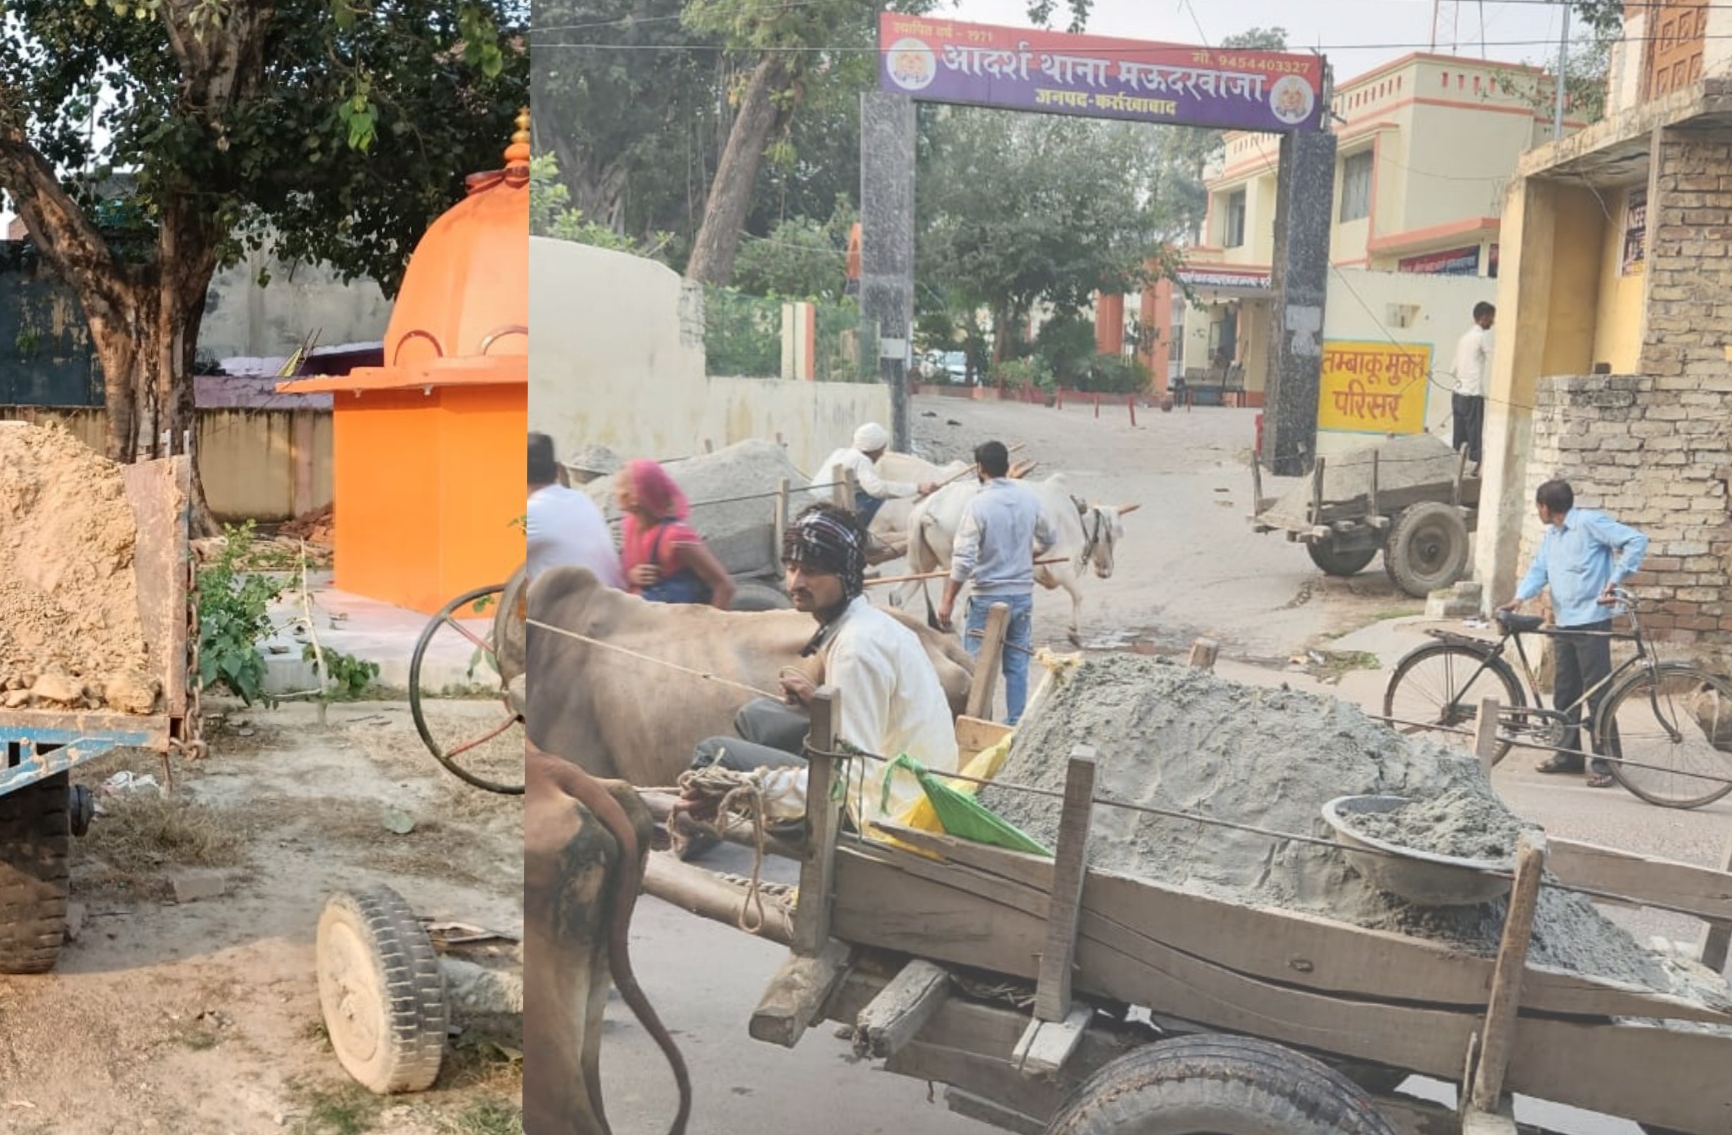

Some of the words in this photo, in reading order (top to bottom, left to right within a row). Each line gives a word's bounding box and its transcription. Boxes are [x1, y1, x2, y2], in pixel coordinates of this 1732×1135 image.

[942, 41, 1031, 81] आदर्श
[1040, 54, 1111, 87] थाना
[1332, 378, 1403, 422] परिसर
